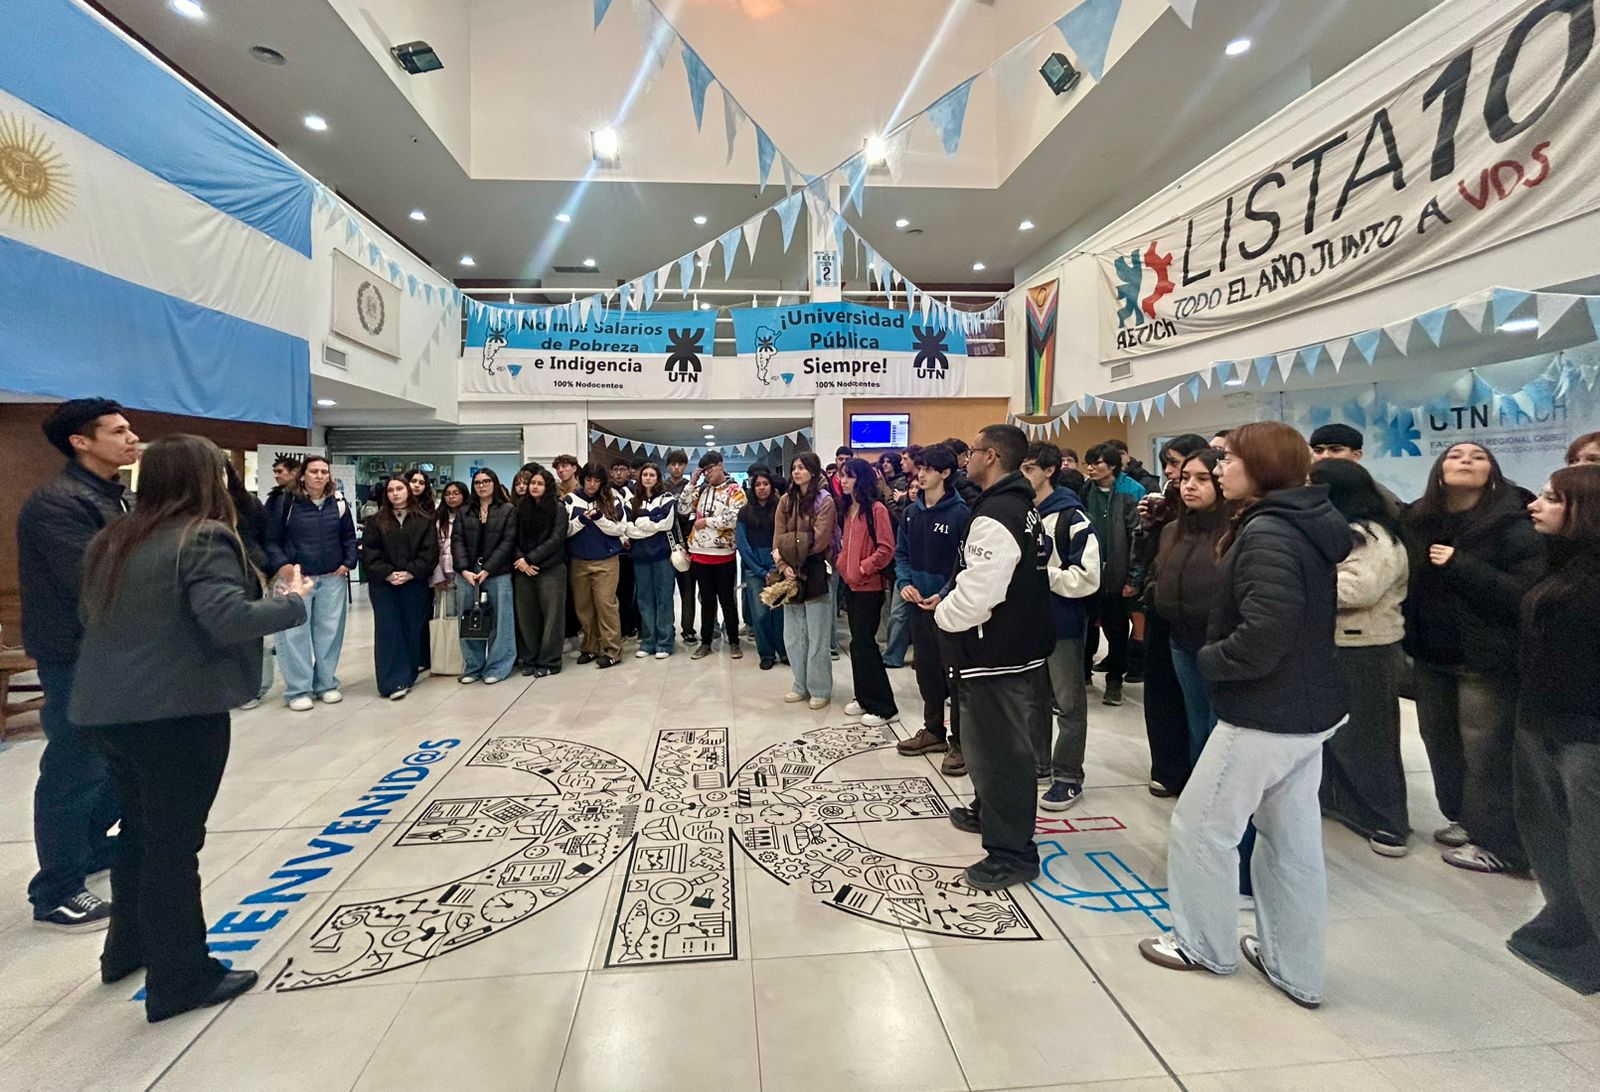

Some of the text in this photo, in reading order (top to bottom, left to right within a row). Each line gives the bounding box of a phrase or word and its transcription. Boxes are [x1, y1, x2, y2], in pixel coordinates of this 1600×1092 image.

[1182, 0, 1596, 287] LISTA 10
[1174, 141, 1551, 320] TODO EL AÑO JUNTO A VDS
[521, 318, 547, 331] No
[594, 320, 663, 336] Salarios
[781, 307, 905, 330] ¡Universidad
[541, 337, 640, 353] de Pobreza
[810, 330, 880, 350] Pública
[534, 356, 643, 375] e Indigencia
[803, 357, 888, 377] Siempre!
[916, 368, 945, 380] UTN
[553, 380, 624, 389] 100% Nodocentes
[668, 371, 698, 383] UTN
[815, 380, 835, 389] 100%
[933, 522, 949, 534] 741
[130, 737, 461, 1000] IENVENID@S
